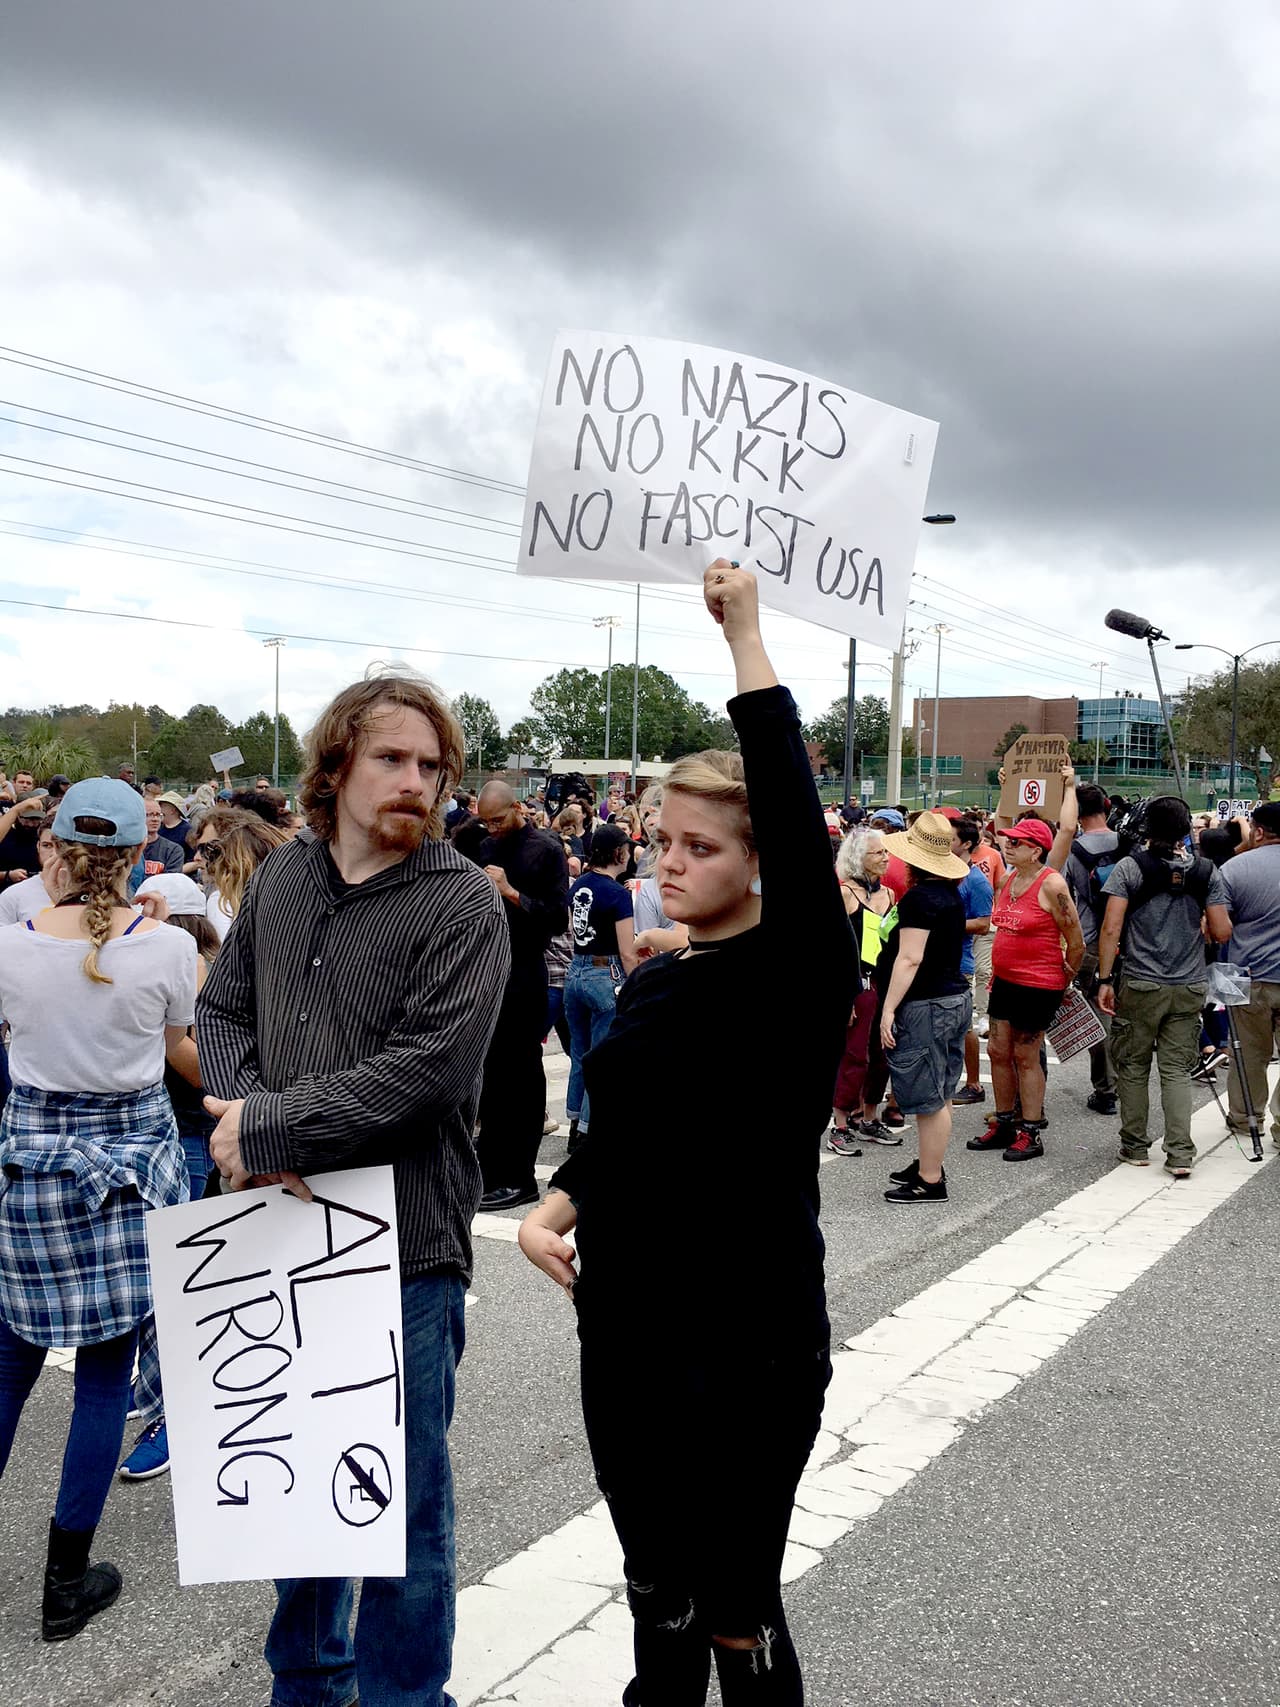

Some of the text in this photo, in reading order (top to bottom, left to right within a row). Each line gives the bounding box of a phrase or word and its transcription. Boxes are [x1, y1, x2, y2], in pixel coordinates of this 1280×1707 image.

[555, 344, 848, 460] NO NAZIS
[574, 412, 805, 494] NO KKK
[528, 481, 884, 616] NO FASCIST USA
[1011, 758, 1033, 775] IT
[1015, 740, 1065, 756] WHATEVER
[175, 1201, 295, 1507] WRONG
[282, 1187, 402, 1427] ALT
